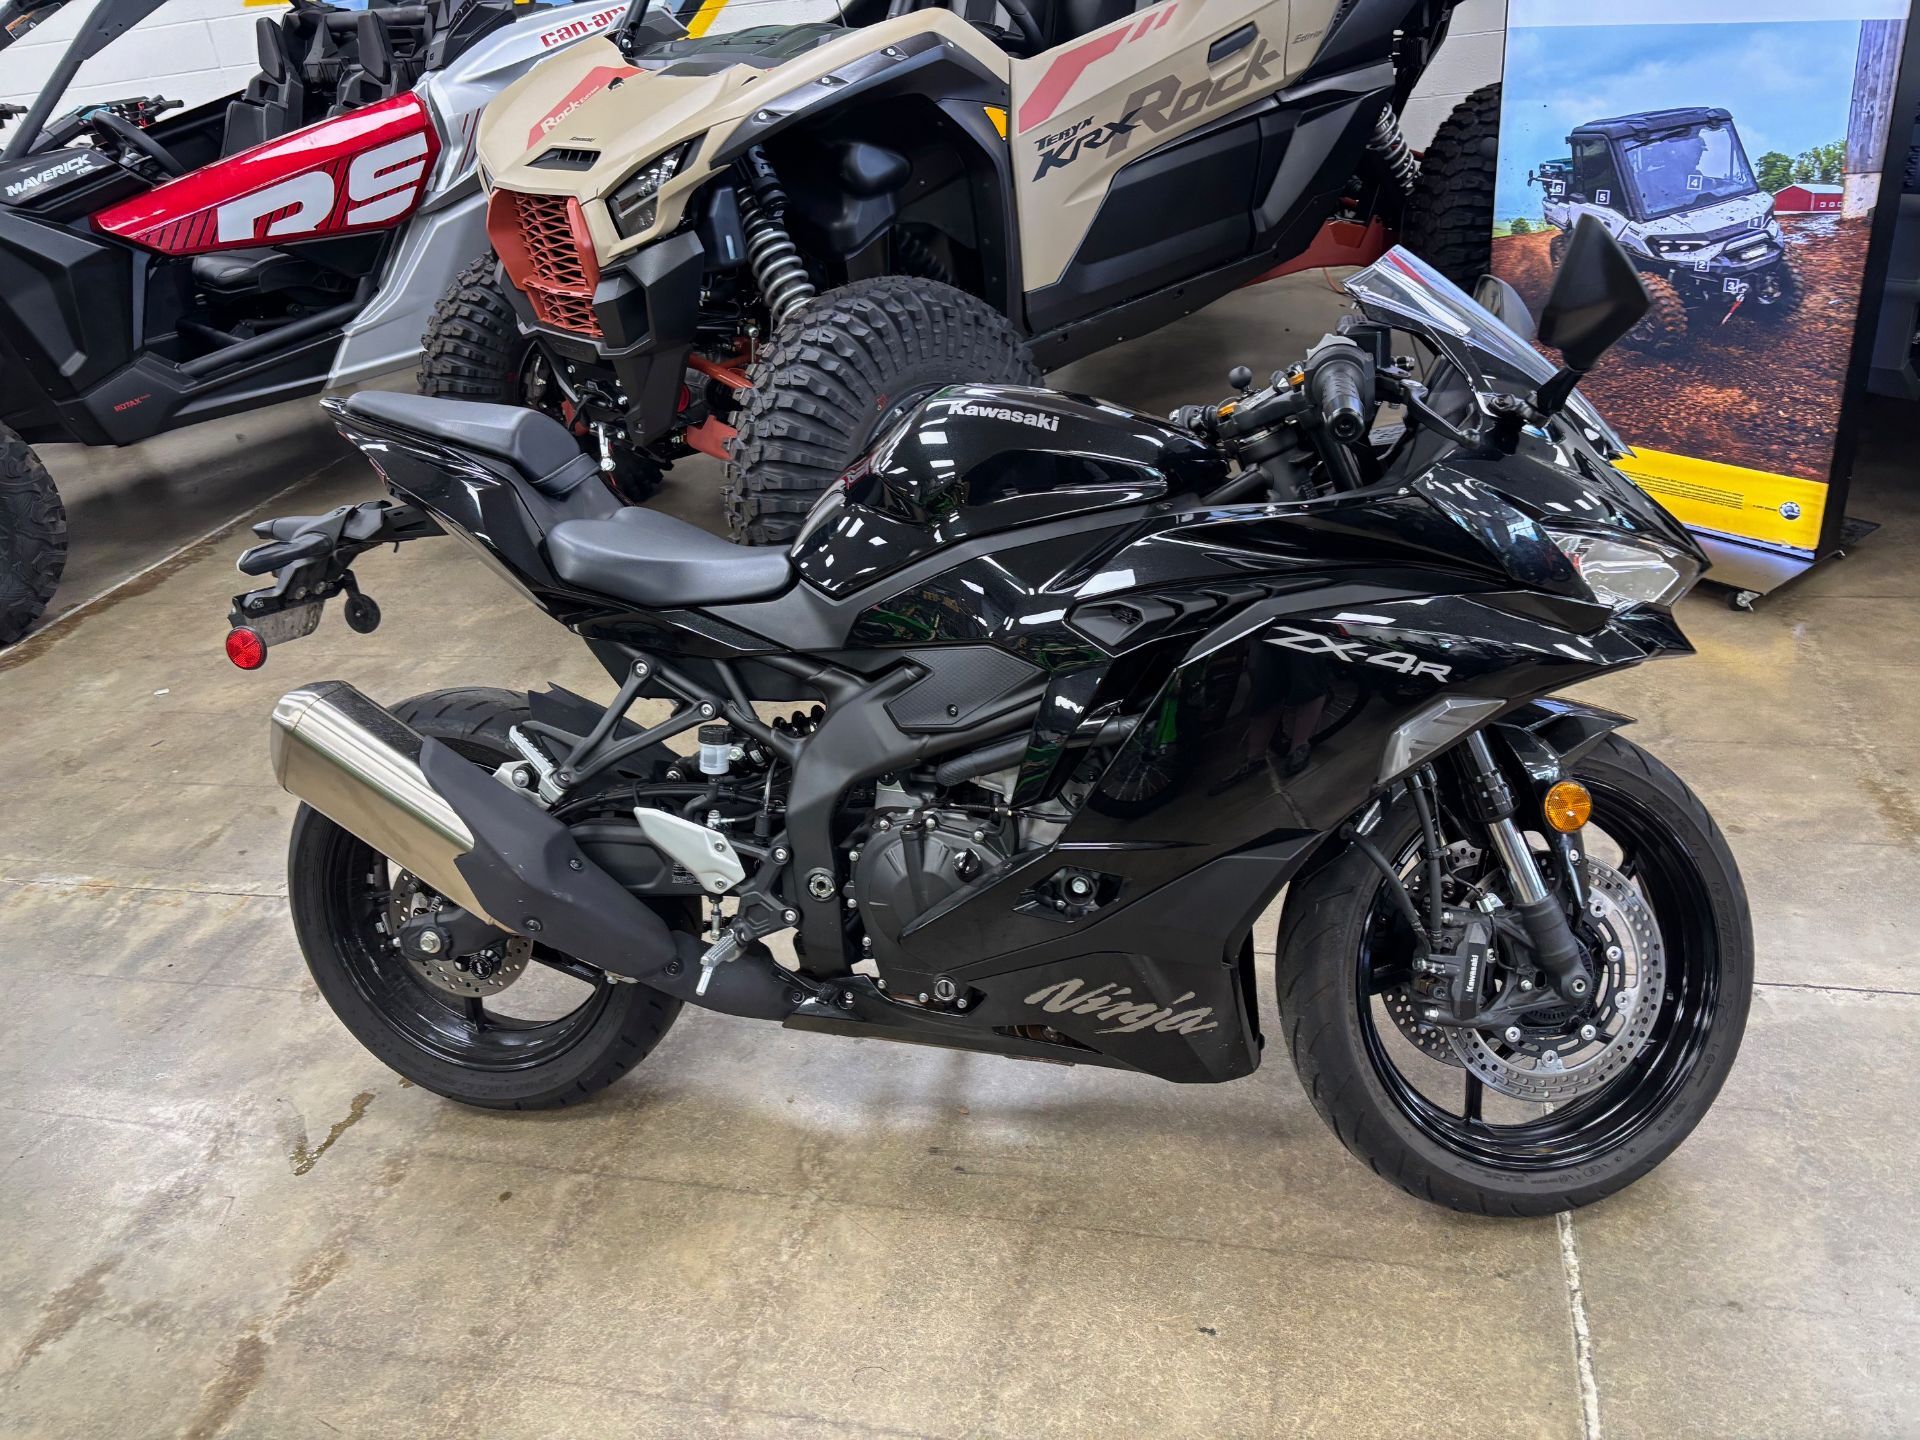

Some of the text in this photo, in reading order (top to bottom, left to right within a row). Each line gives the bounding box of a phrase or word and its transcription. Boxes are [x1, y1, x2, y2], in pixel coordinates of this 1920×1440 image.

[1031, 105, 1142, 182] KRX
[4, 153, 92, 197] MAVERICK
[1599, 194, 1606, 202] 5
[947, 400, 1060, 432] Kawasaki
[1263, 626, 1452, 683] ZX-4R
[1023, 978, 1219, 1035] Ninja
